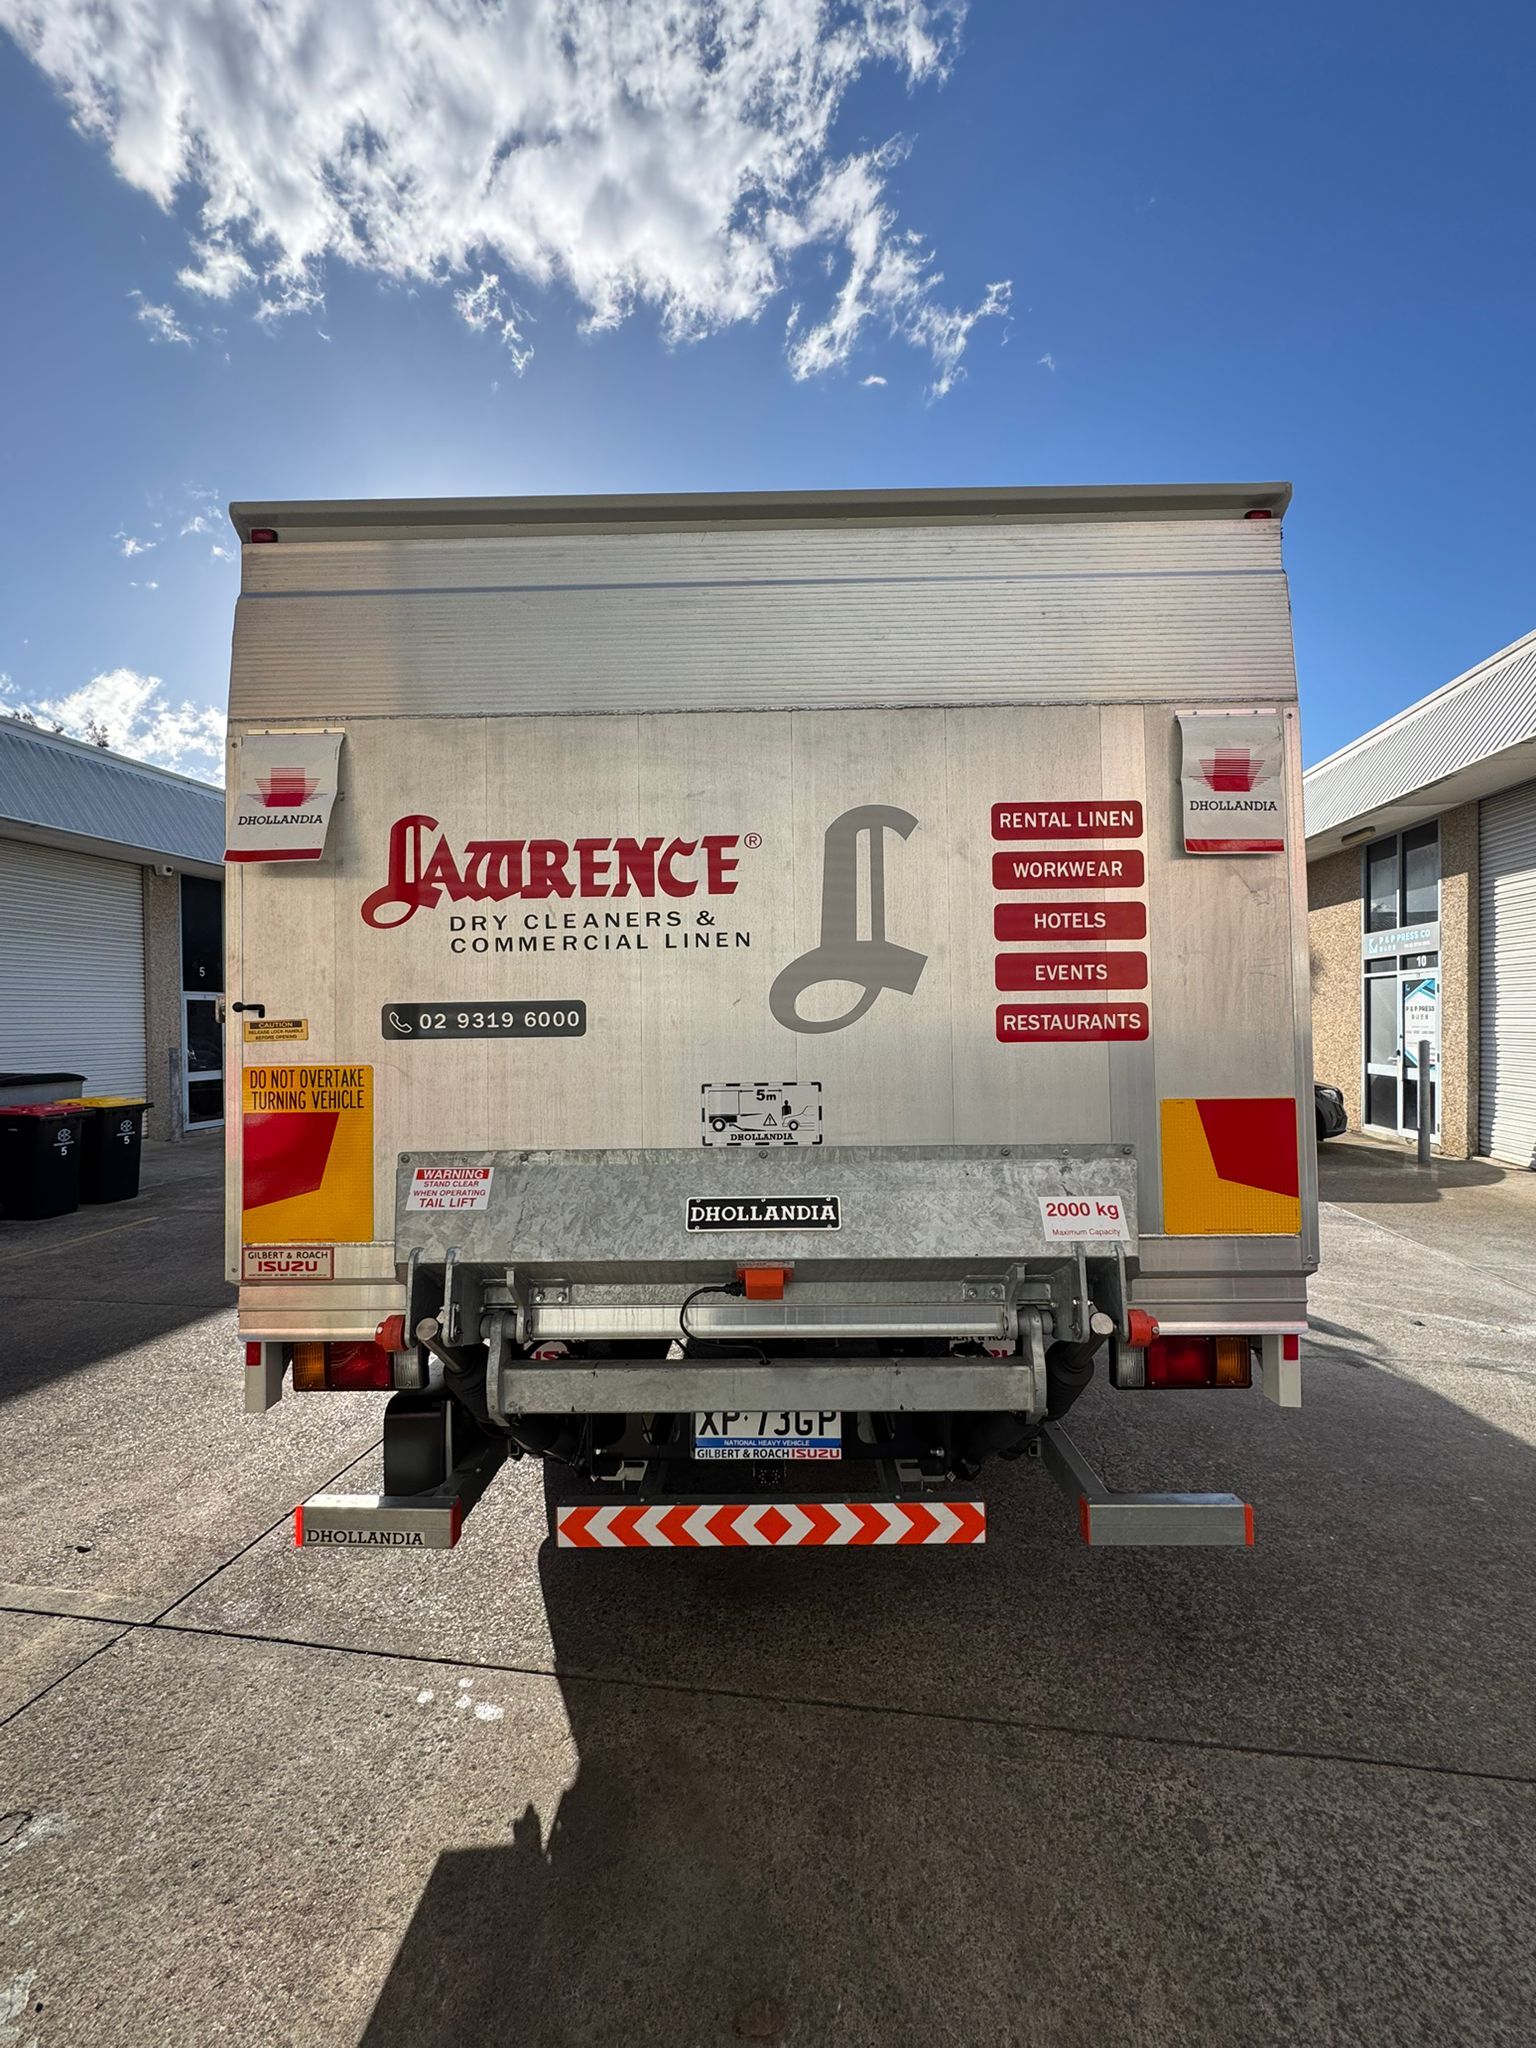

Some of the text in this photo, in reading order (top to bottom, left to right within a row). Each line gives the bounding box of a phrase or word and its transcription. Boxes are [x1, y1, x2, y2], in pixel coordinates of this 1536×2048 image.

[1189, 800, 1278, 812] DHOLLANDIA
[238, 814, 323, 826] DHOLLANDIA
[999, 810, 1134, 829] RENTAL LINEN
[1012, 860, 1123, 878] WORKWEAR
[450, 910, 717, 932] DRY CLEANERS &
[1034, 911, 1107, 929] HOTELS
[1396, 930, 1419, 942] PRESS
[1420, 928, 1431, 938] CO
[450, 931, 752, 953] COMMERCIAL LINEN
[1416, 955, 1427, 968] 10
[199, 966, 206, 977] 5
[1034, 963, 1108, 981] EVENTS
[258, 1021, 294, 1029] CAUTION
[419, 1010, 580, 1029] 02 9319 6000
[1003, 1012, 1142, 1031] RESTAURANTS
[250, 1068, 365, 1089] DO NOT OVERTAKE
[251, 1089, 365, 1111] TURNING VEHICLE
[756, 1089, 777, 1101] 5m
[124, 1136, 130, 1145] 5
[730, 1133, 794, 1142] DHOLLANDIA
[61, 1146, 68, 1156] 5
[423, 1169, 485, 1179] WARNING
[423, 1180, 451, 1188] STAND
[413, 1189, 438, 1197] WHEN
[419, 1197, 477, 1208] TAIL LIFT
[690, 1205, 837, 1222] DHOLLANDIA
[1045, 1201, 1120, 1220] 2000 kg
[1052, 1227, 1121, 1237] Maximum Capacity
[248, 1251, 329, 1260] GILBERT & ROACH
[257, 1260, 318, 1272] ISUZU
[697, 1448, 840, 1459] GILBERT & ROACH ISUZU
[307, 1530, 423, 1545] DHOLLANDIA
